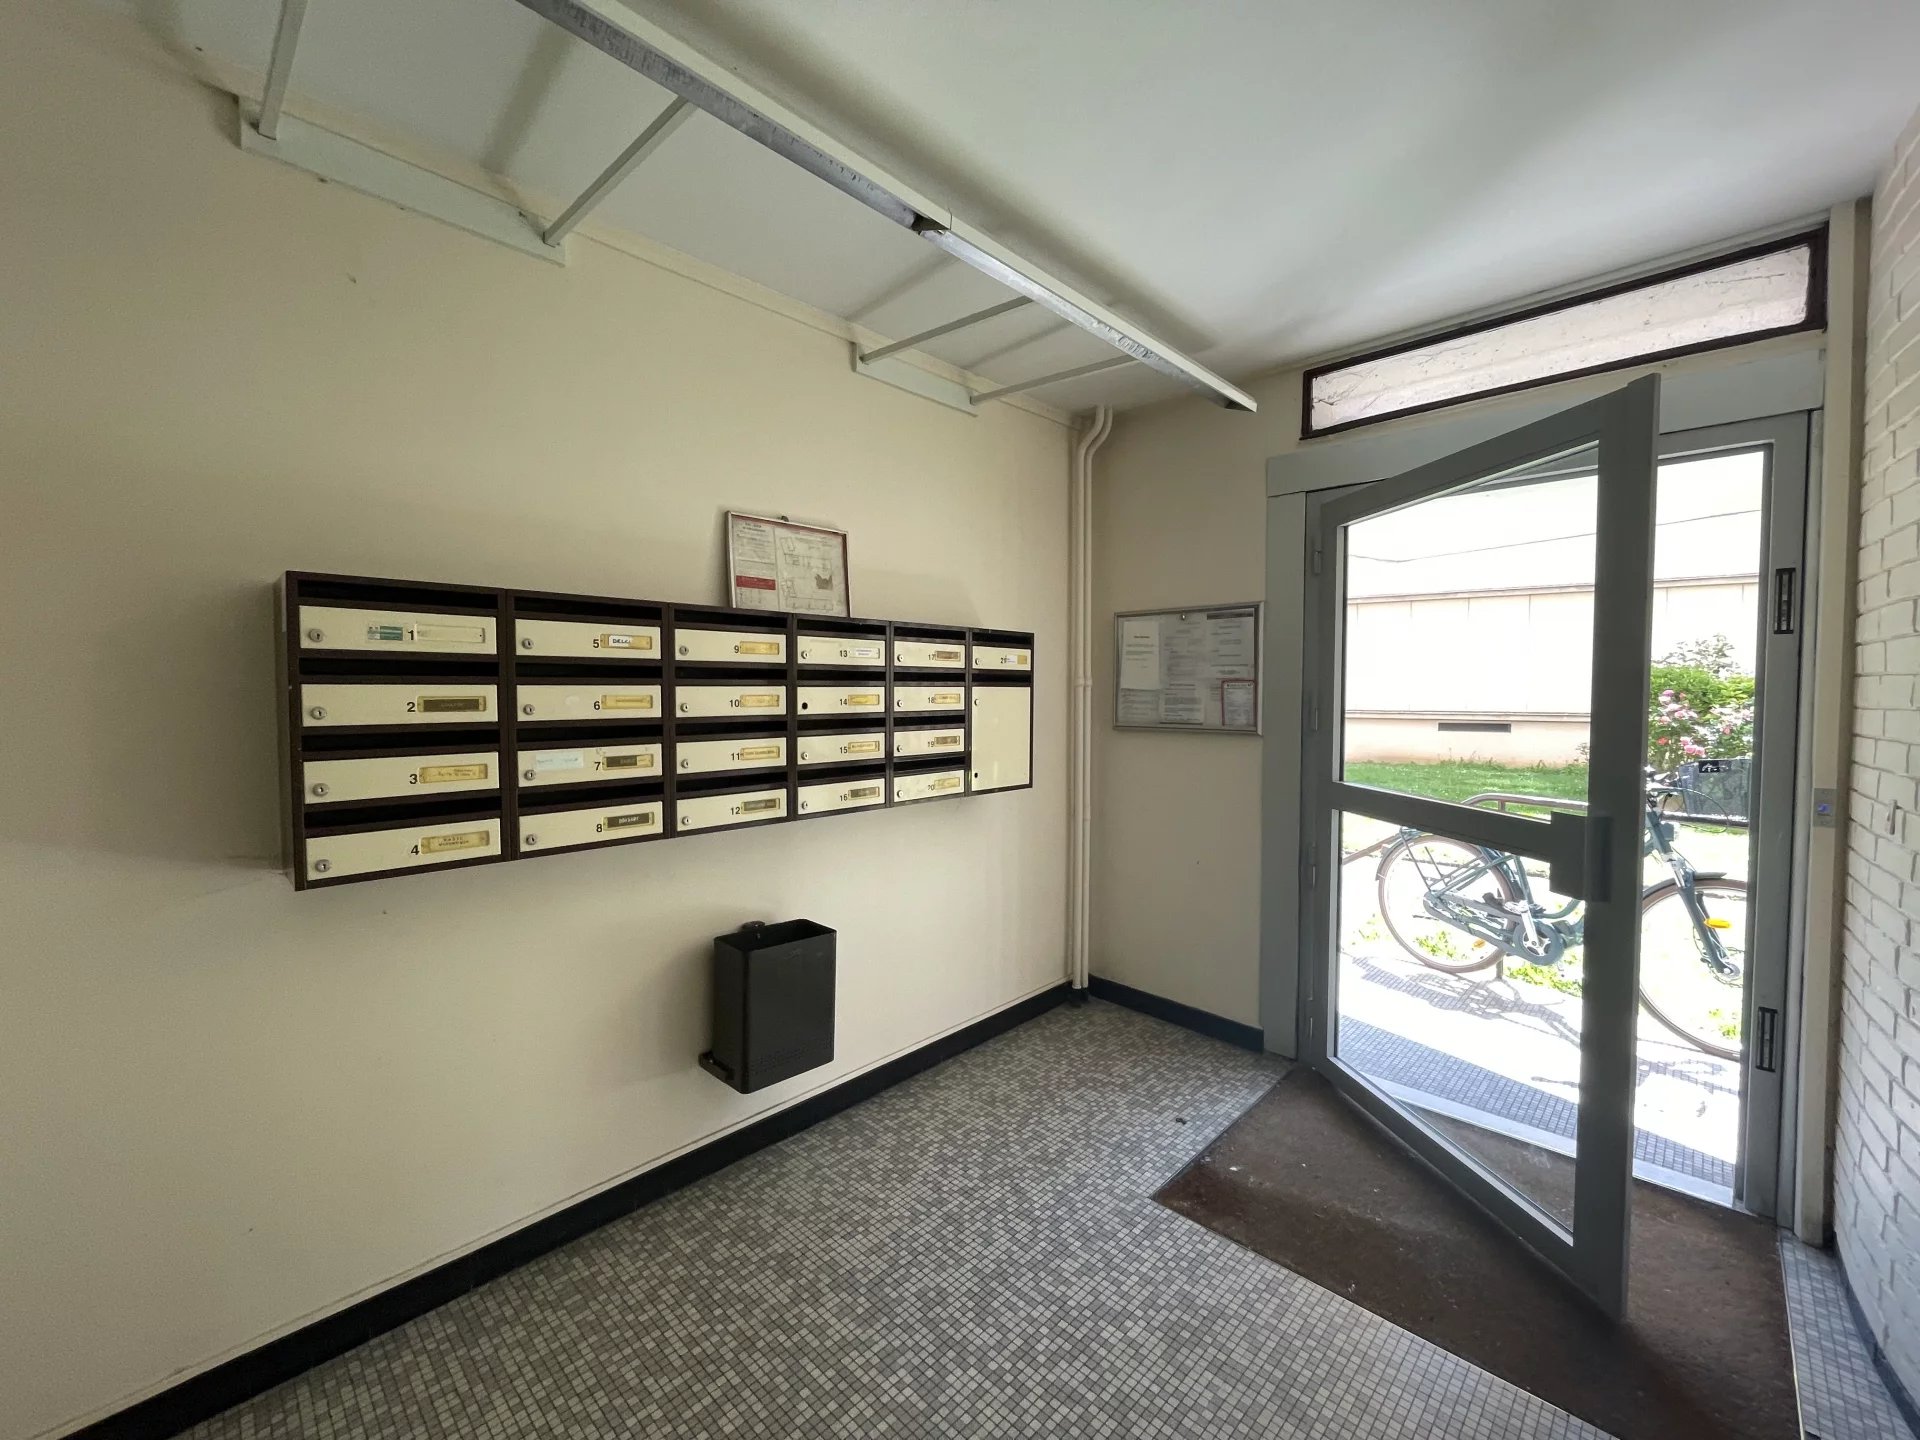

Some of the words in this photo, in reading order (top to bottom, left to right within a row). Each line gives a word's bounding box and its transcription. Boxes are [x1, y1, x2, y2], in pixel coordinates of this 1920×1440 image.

[407, 629, 414, 641] 1
[592, 639, 600, 649] 5
[733, 645, 740, 654] 9
[839, 650, 848, 658] 13
[593, 701, 601, 710] 6
[729, 699, 740, 708] 10
[839, 698, 848, 706] 14
[406, 702, 416, 713] 2
[839, 746, 848, 754] 15
[731, 752, 740, 761] 11
[594, 761, 601, 771] 7
[409, 773, 418, 785] 3
[839, 794, 848, 802] 16
[730, 806, 741, 816] 12
[596, 823, 603, 833] 8
[411, 844, 420, 856] 4
